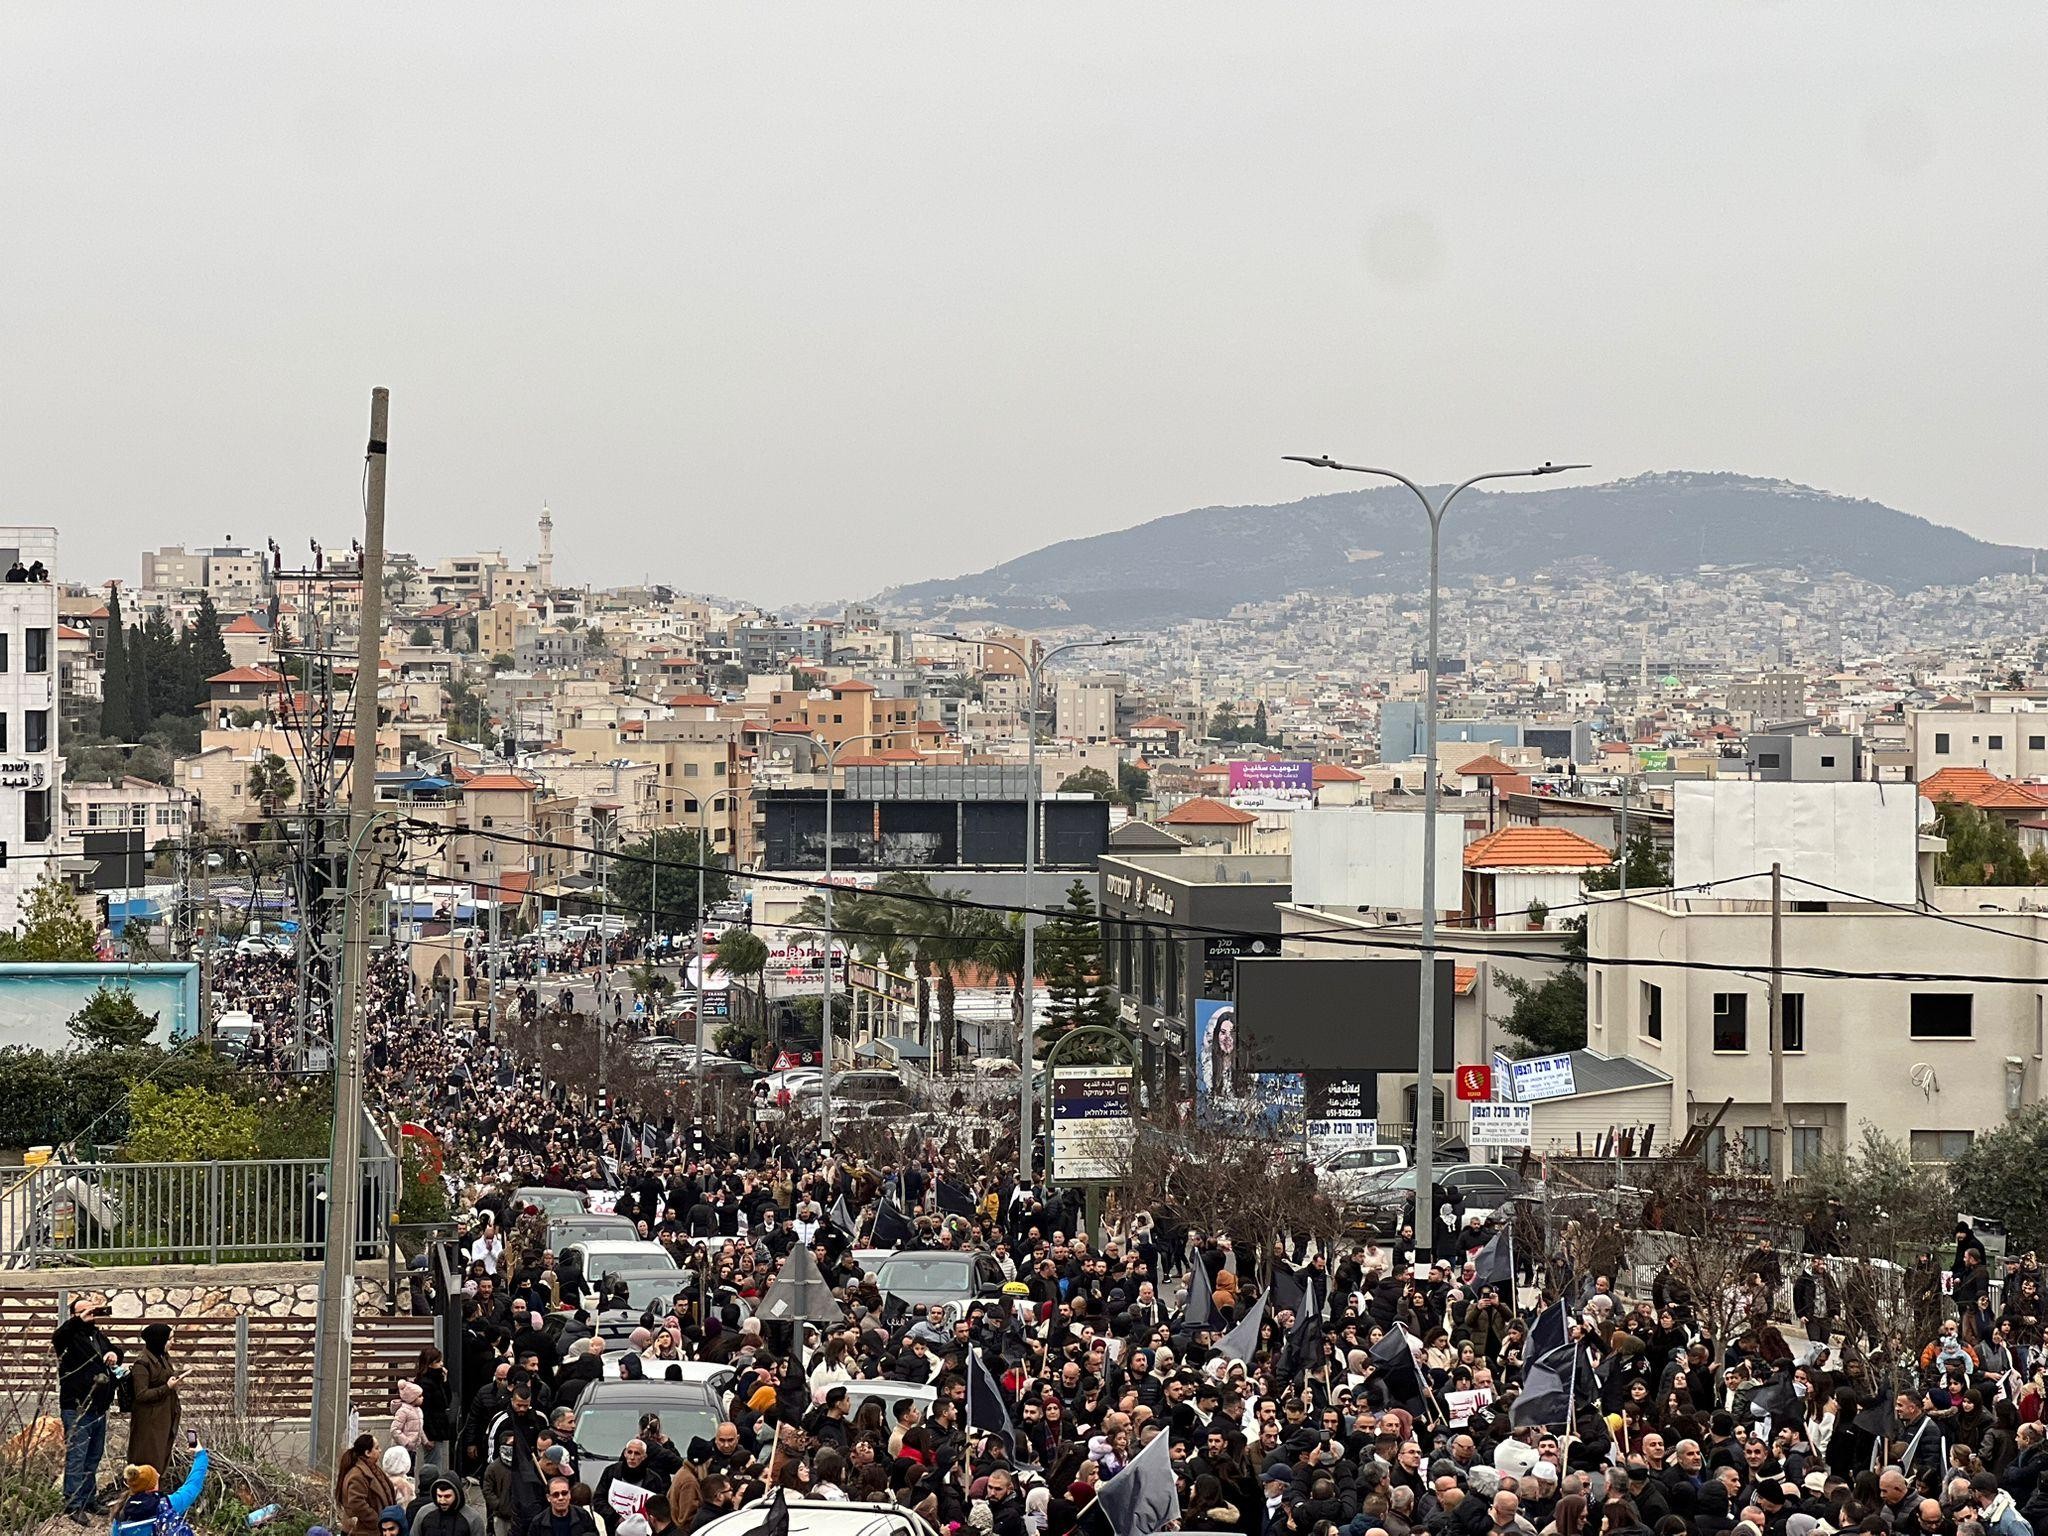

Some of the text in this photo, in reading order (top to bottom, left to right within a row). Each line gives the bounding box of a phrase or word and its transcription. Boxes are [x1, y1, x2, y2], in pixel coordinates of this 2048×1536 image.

[2, 762, 29, 772] לשכת
[2, 777, 29, 789] نقابة
[1534, 1061, 1551, 1073] מרכז
[1554, 1057, 1569, 1071] קירור
[1513, 1063, 1532, 1079] הצפון
[1083, 1089, 1104, 1098] עתיקה
[1472, 1106, 1530, 1121] קירור מרכז הצפון
[1333, 1122, 1352, 1134] מרכז
[1356, 1122, 1375, 1136] קירור
